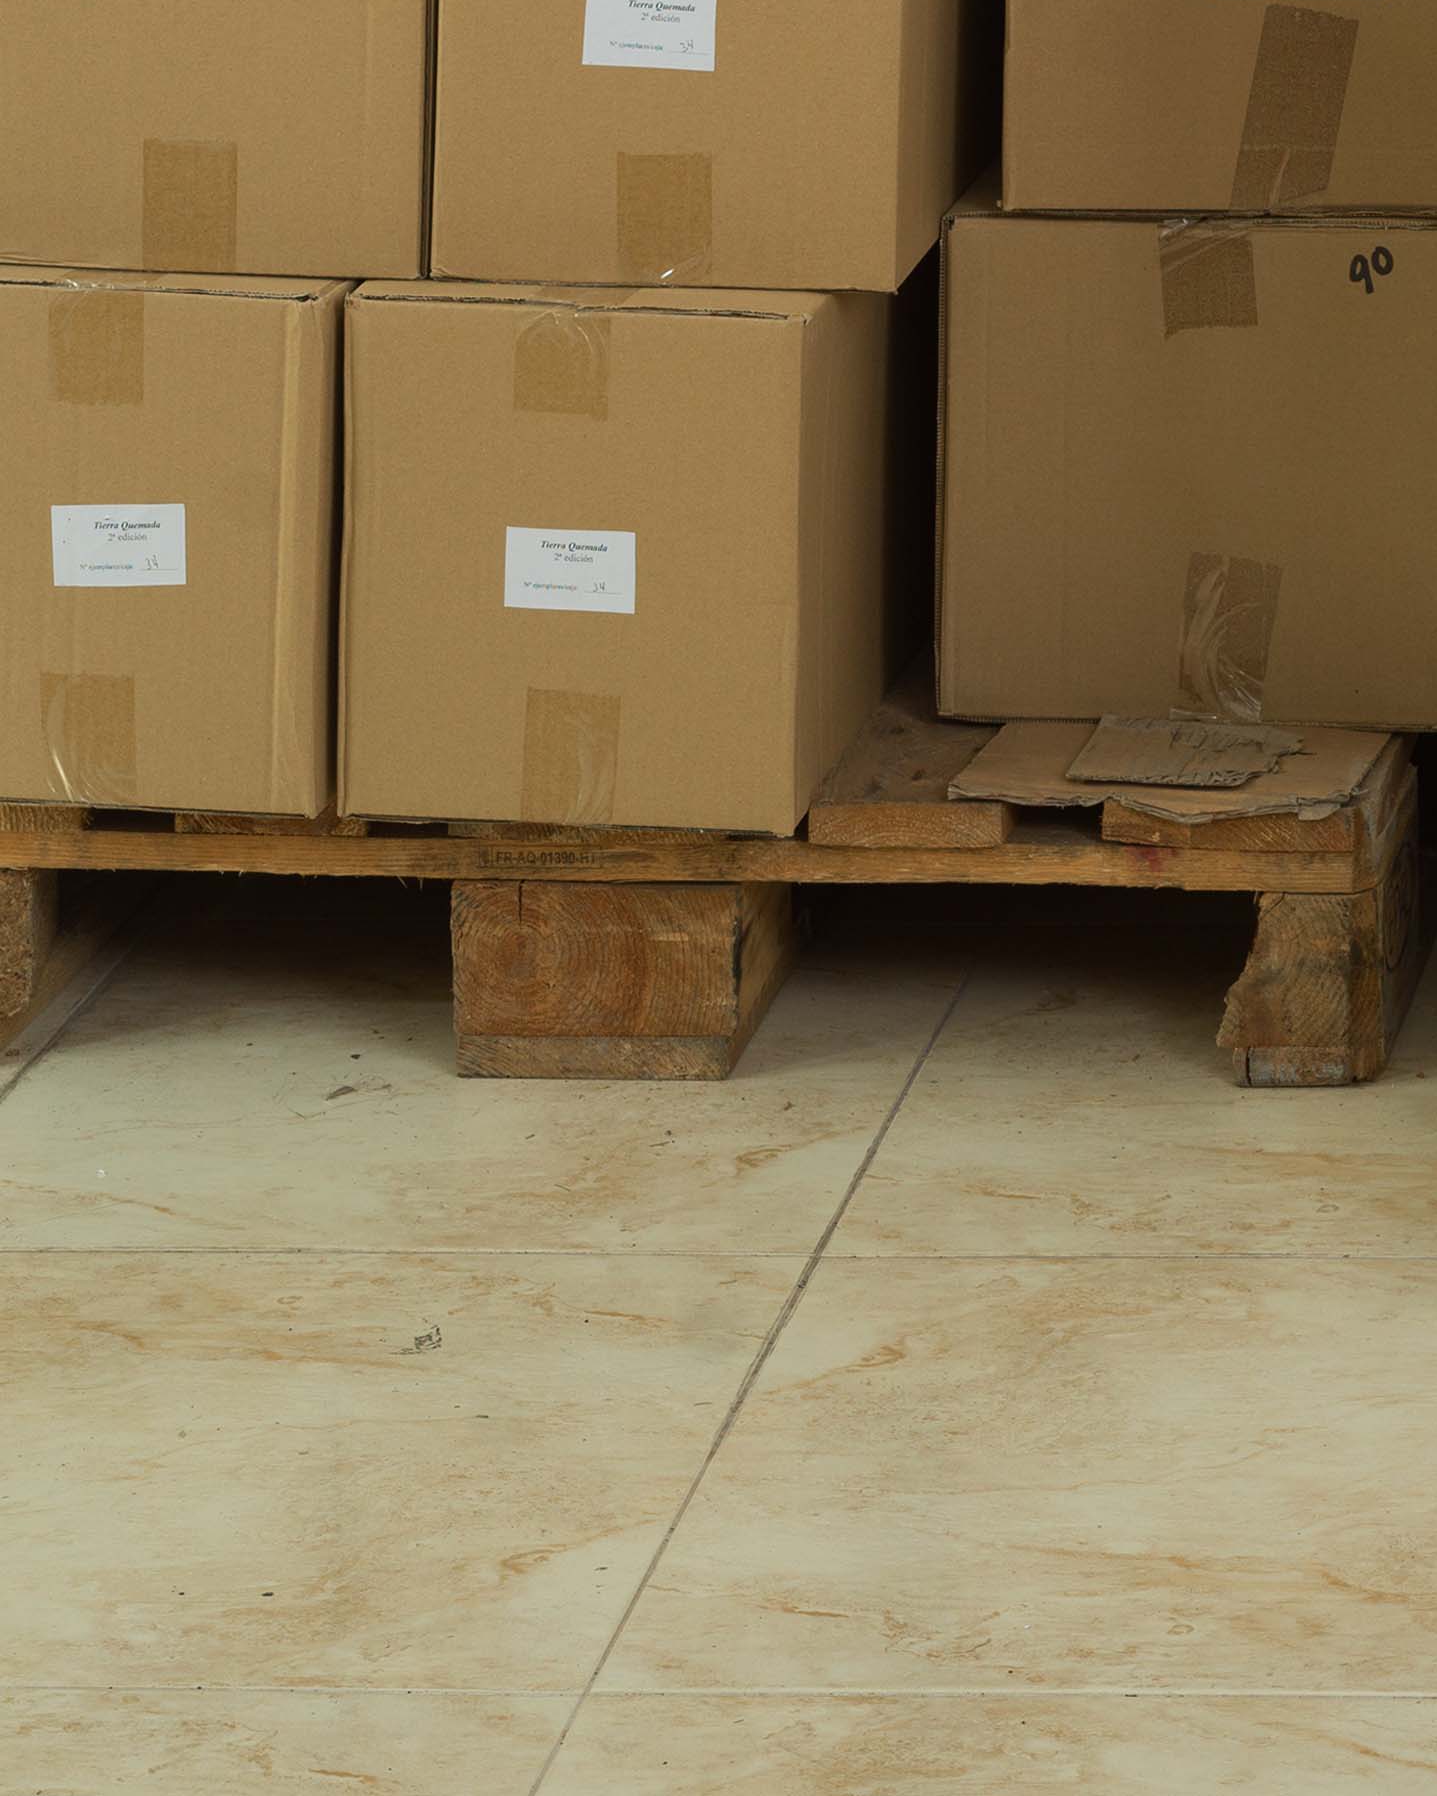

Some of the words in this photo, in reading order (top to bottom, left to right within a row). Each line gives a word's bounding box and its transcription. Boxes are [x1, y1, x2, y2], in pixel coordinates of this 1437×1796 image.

[628, 0, 653, 9] Tierra
[655, 1, 696, 12] Quemada
[1350, 246, 1394, 294] 90
[94, 521, 119, 530] Tierra
[120, 520, 161, 531] Quemada
[541, 540, 566, 549] Tierra
[568, 541, 608, 552] Quemada
